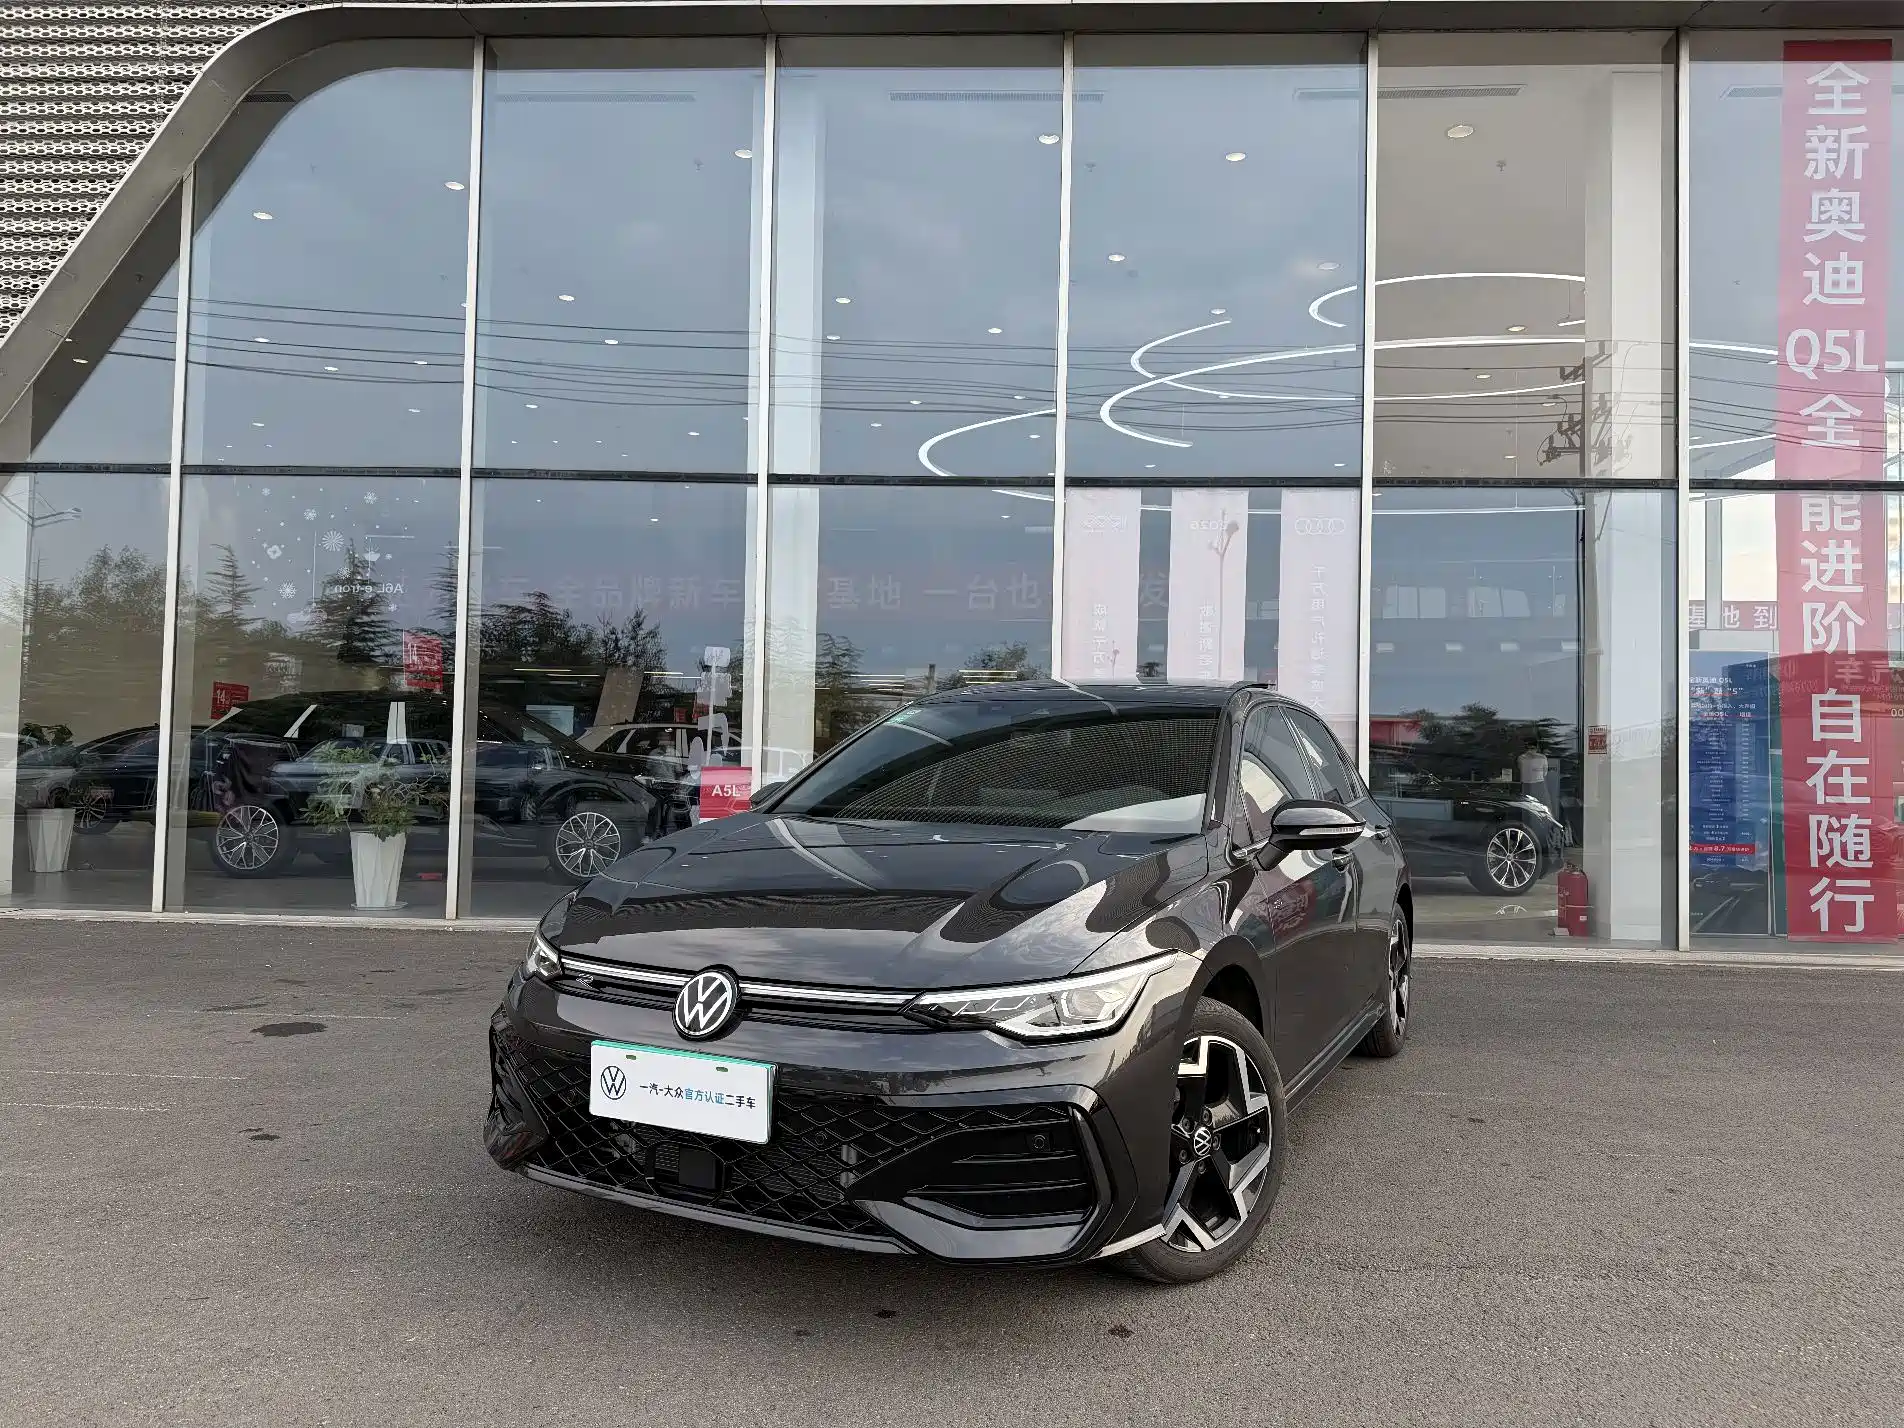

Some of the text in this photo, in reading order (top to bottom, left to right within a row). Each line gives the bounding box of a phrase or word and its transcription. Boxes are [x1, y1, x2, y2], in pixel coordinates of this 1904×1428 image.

[711, 784, 741, 797] A5L
[1805, 687, 1875, 933] 自在随行
[639, 1082, 756, 1109] 一汽-大众官方认证二手车
